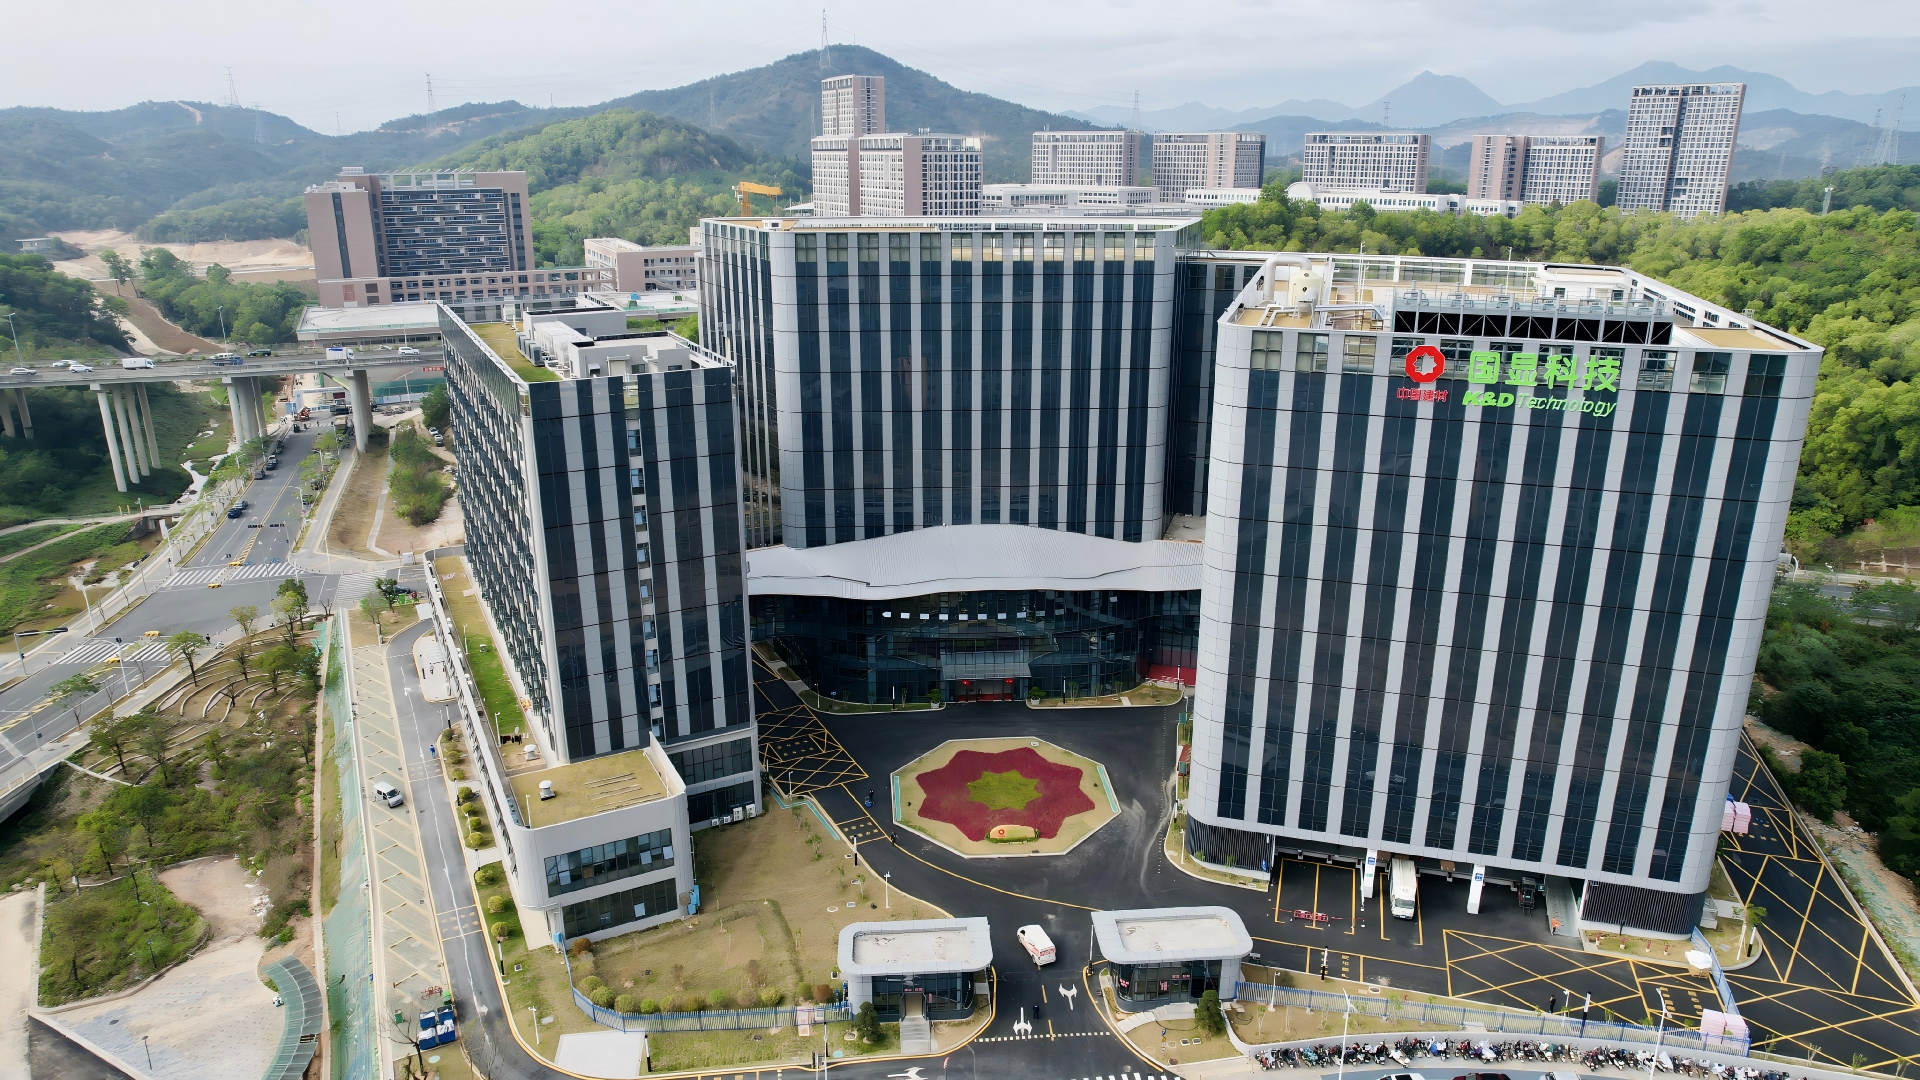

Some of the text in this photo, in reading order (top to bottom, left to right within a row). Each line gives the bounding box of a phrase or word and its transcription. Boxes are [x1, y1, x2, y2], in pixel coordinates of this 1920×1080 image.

[1467, 350, 1621, 393] 国显科技
[1461, 390, 1617, 418] K&D Technology
